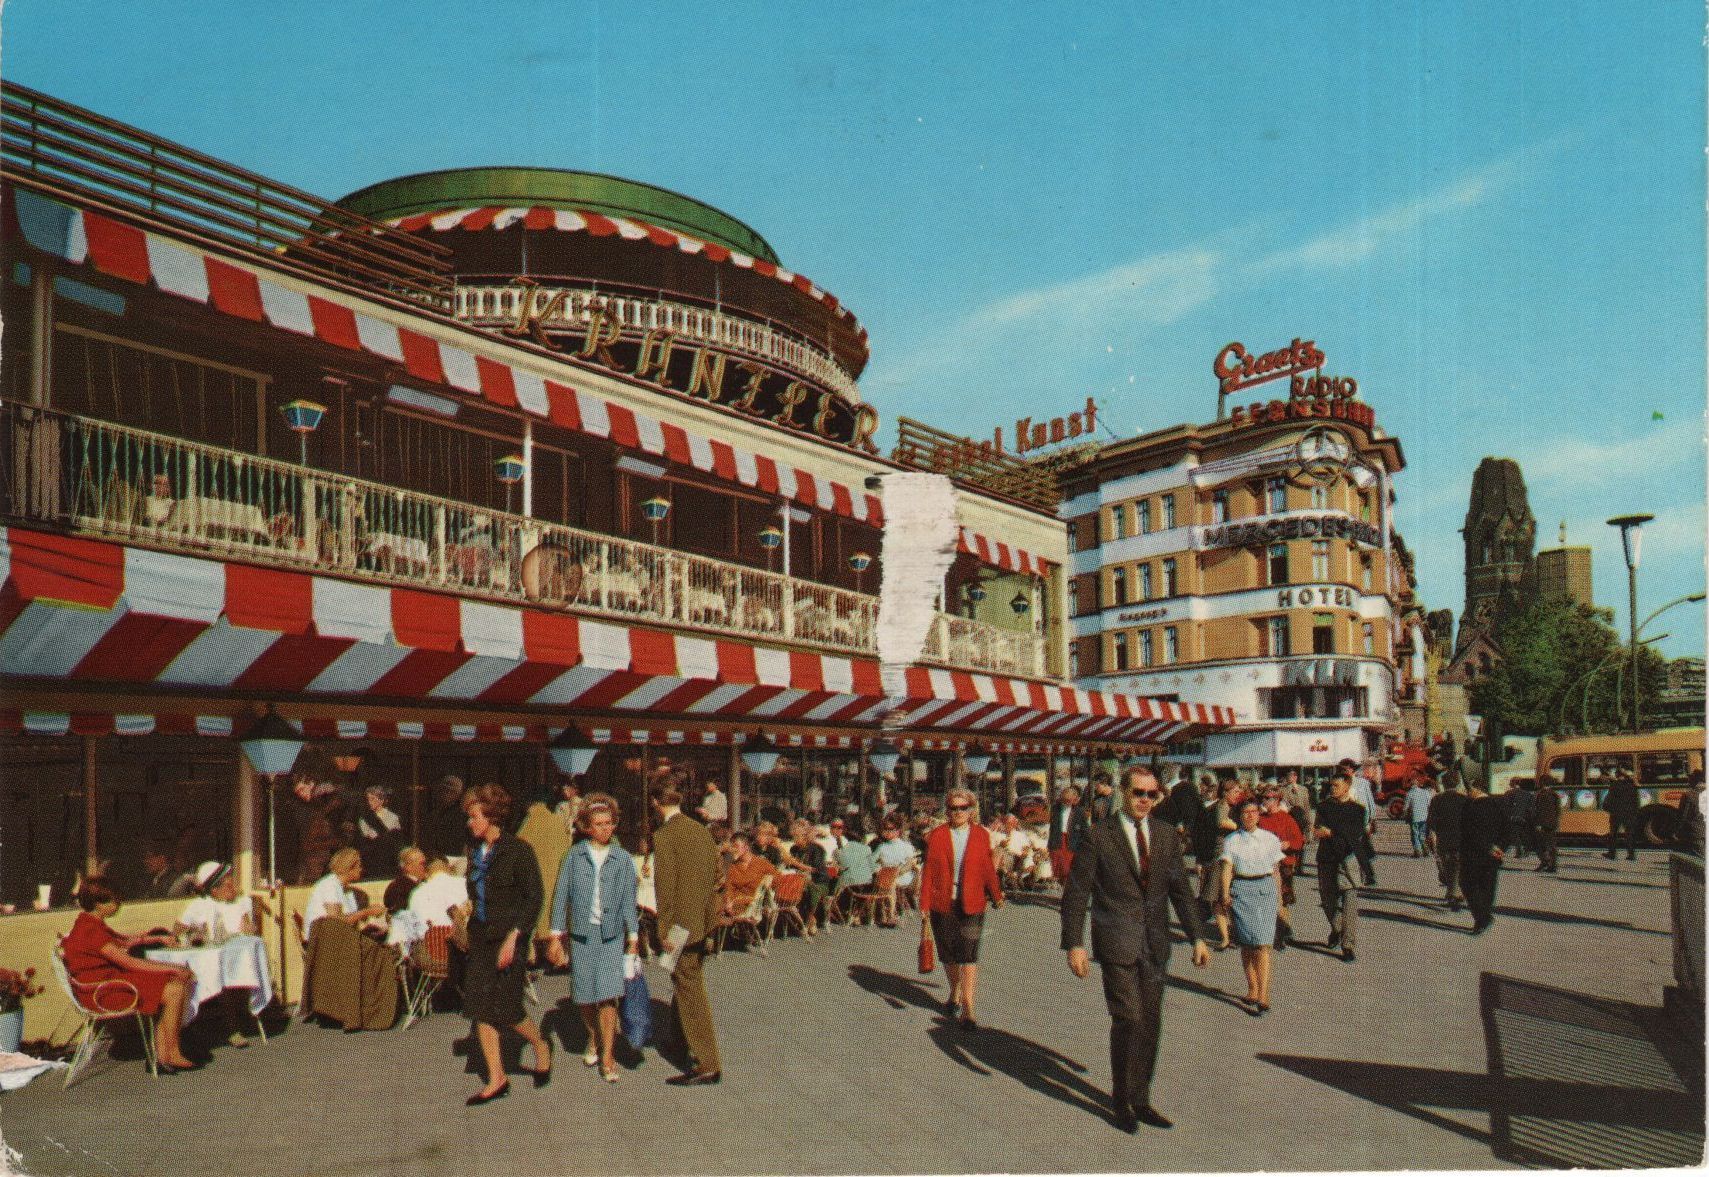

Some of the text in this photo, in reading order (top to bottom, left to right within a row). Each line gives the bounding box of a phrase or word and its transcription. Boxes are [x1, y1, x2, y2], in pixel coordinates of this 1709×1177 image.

[503, 275, 881, 454] KRANZLER
[1214, 338, 1326, 393] Graetz
[1293, 375, 1358, 397] RADIO
[1016, 397, 1097, 455] Kunst
[1278, 587, 1352, 608] HOTEL
